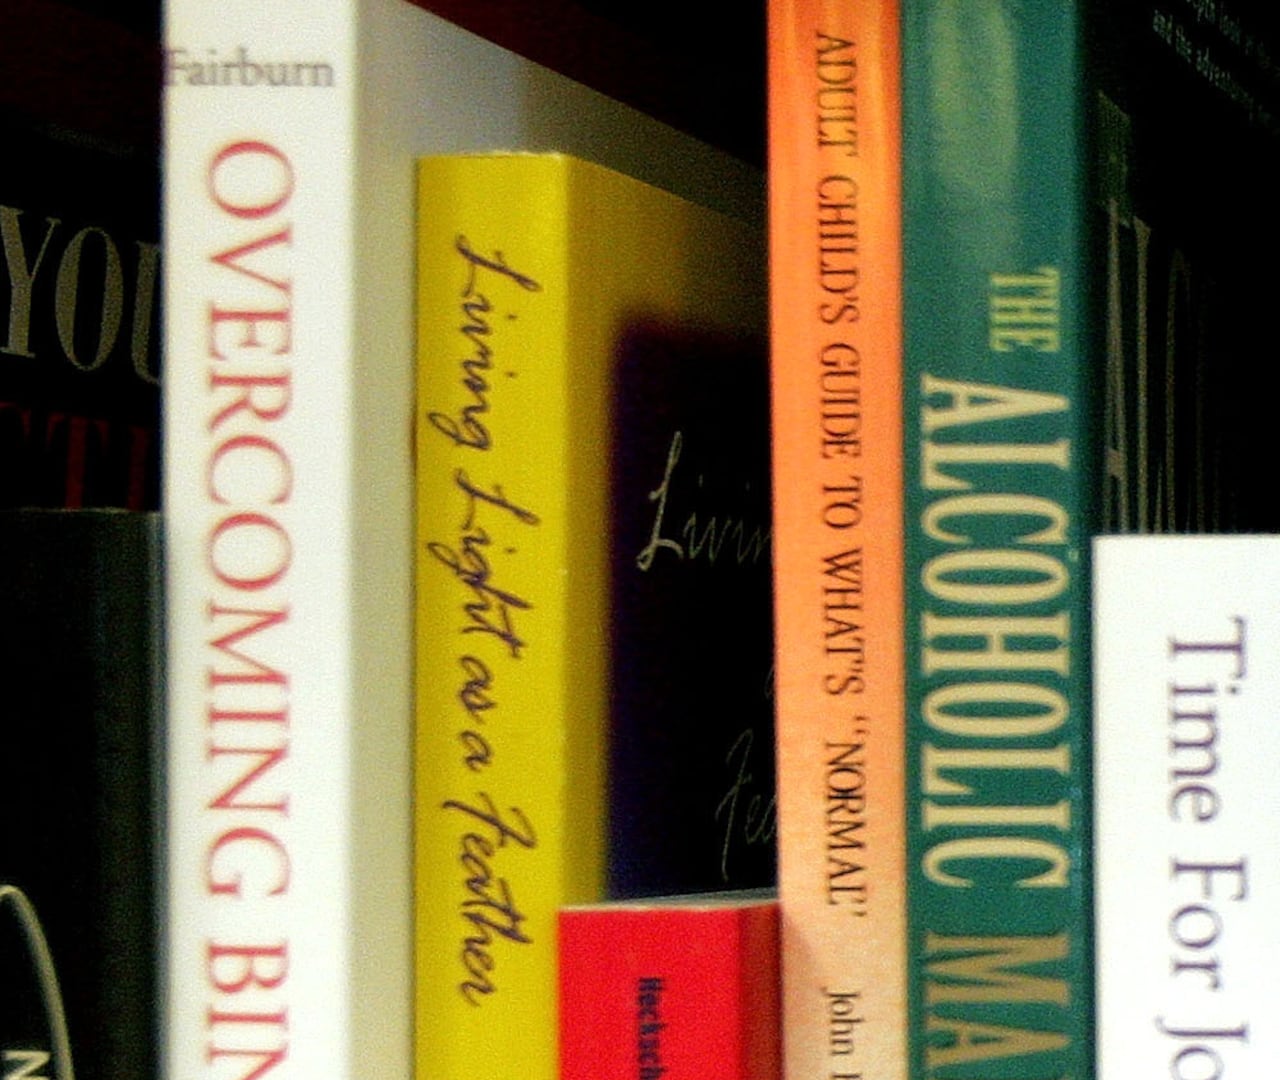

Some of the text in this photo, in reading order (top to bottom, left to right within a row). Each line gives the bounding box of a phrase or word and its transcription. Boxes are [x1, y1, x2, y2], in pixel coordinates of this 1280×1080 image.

[815, 32, 862, 461] ADULT GUIDE
[989, 267, 1061, 352] THE
[205, 141, 295, 898] OVERCOMING
[920, 373, 1071, 888] ALCOHOLIC
[1167, 616, 1249, 824] Time
[1168, 856, 1249, 994] For
